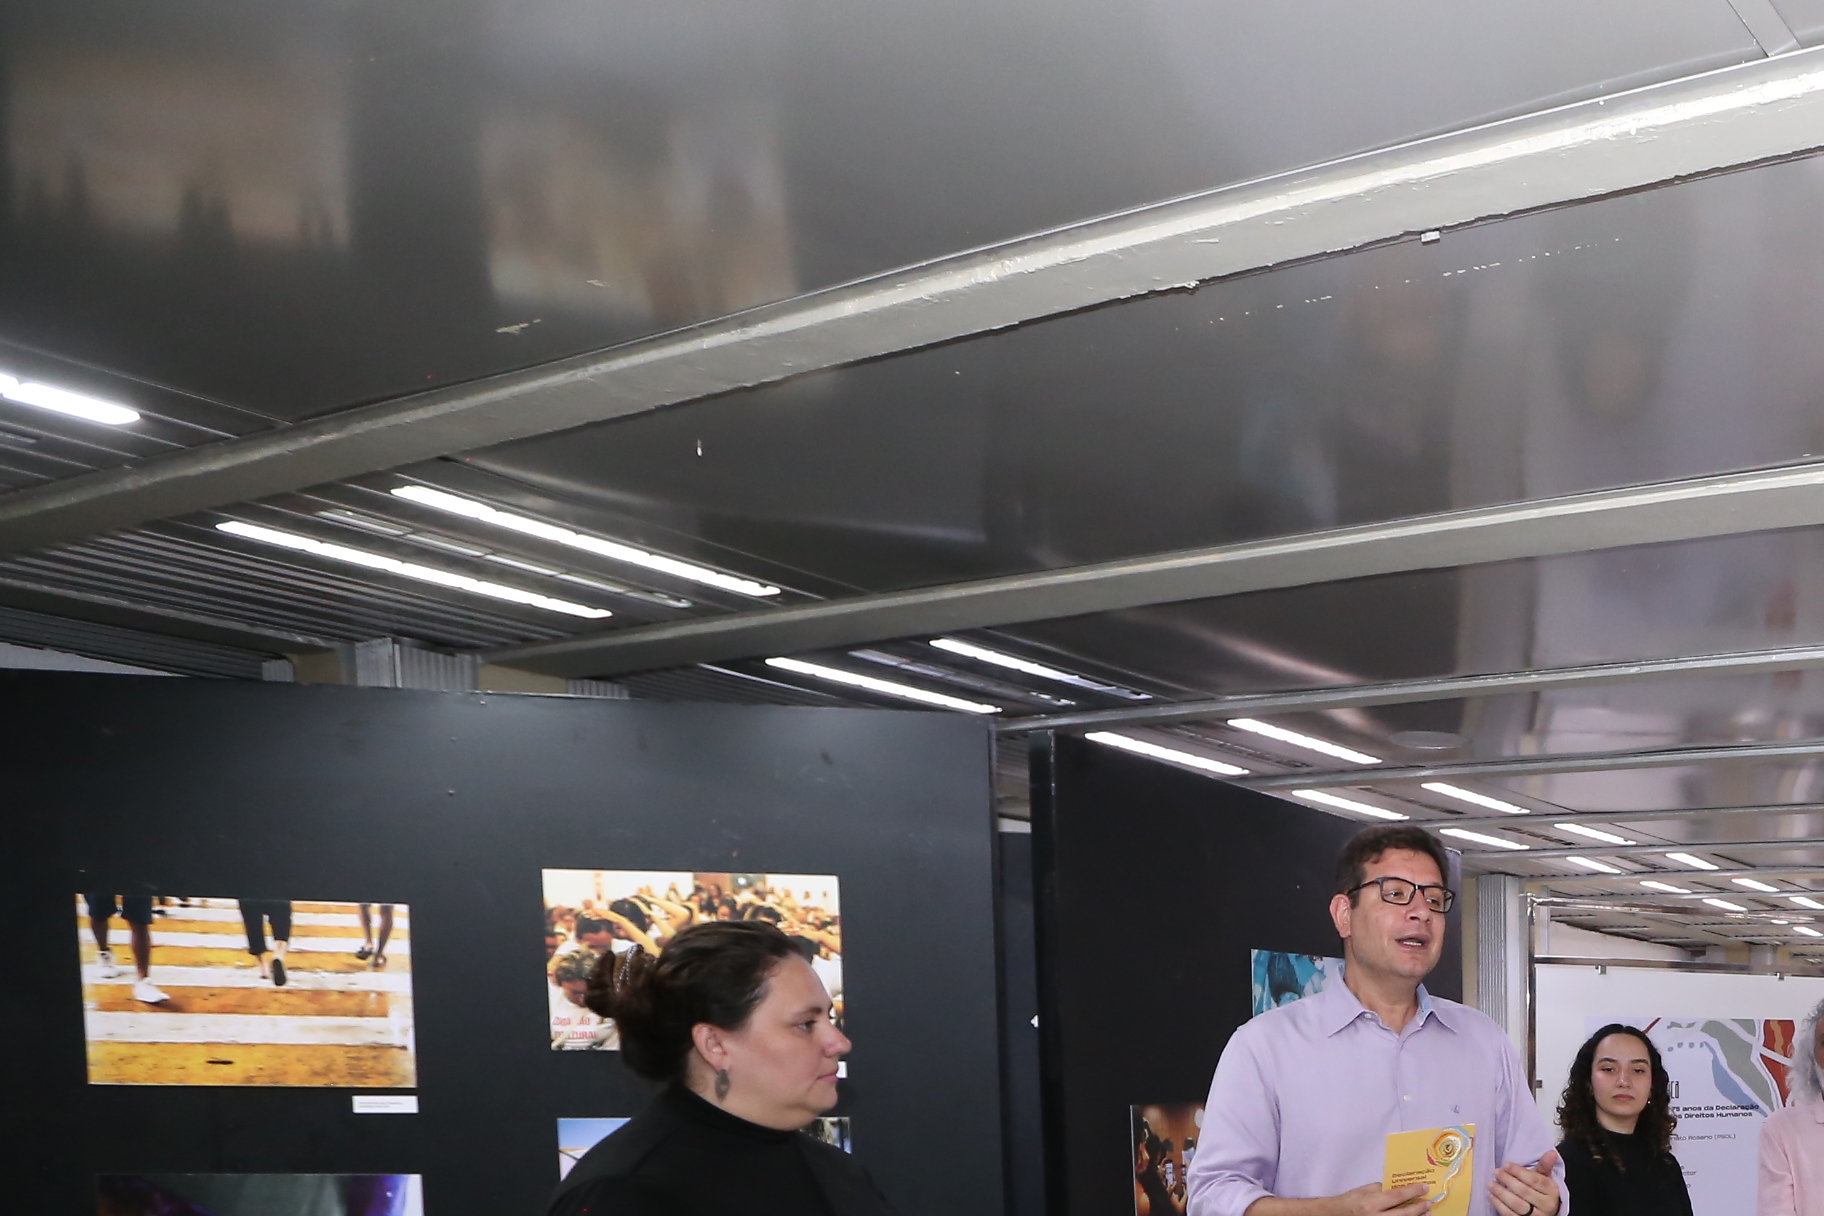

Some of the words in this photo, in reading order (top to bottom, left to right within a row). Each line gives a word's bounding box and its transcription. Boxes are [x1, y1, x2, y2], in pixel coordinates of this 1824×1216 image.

[1715, 1103, 1760, 1112] Declaração
[1391, 1168, 1435, 1178] Declaração
[1391, 1175, 1427, 1184] Universal
